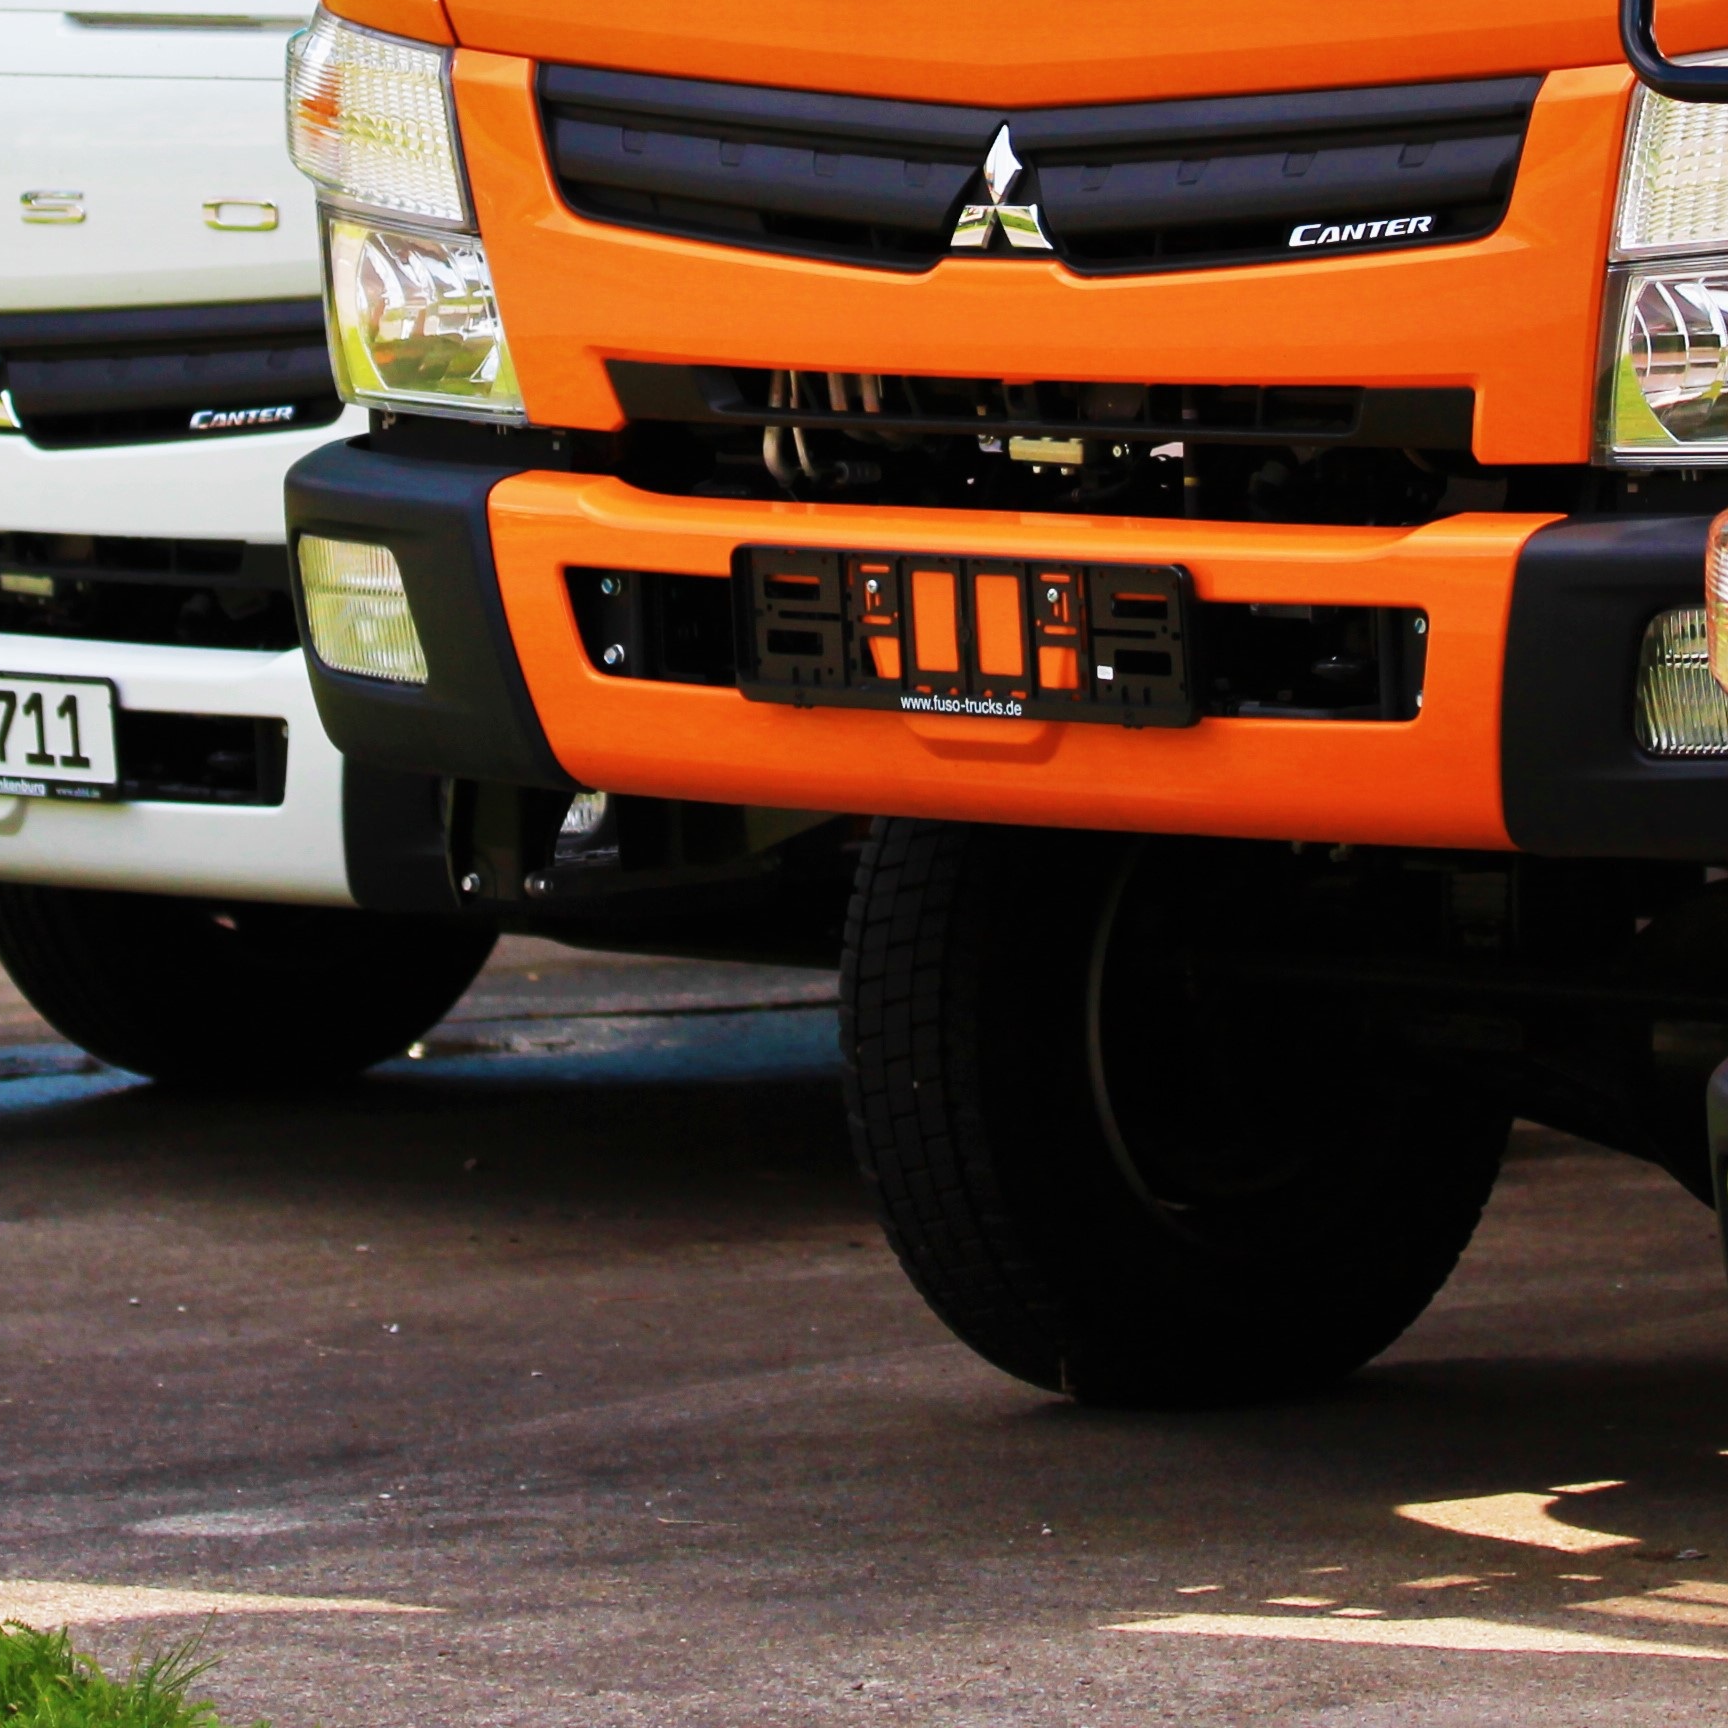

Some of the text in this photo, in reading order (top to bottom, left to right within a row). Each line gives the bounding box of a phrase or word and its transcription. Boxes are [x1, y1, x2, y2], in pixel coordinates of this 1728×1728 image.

[1288, 215, 1433, 247] CANTER
[189, 404, 294, 430] CANTER
[900, 695, 1022, 716] www.fuso-trucks.de
